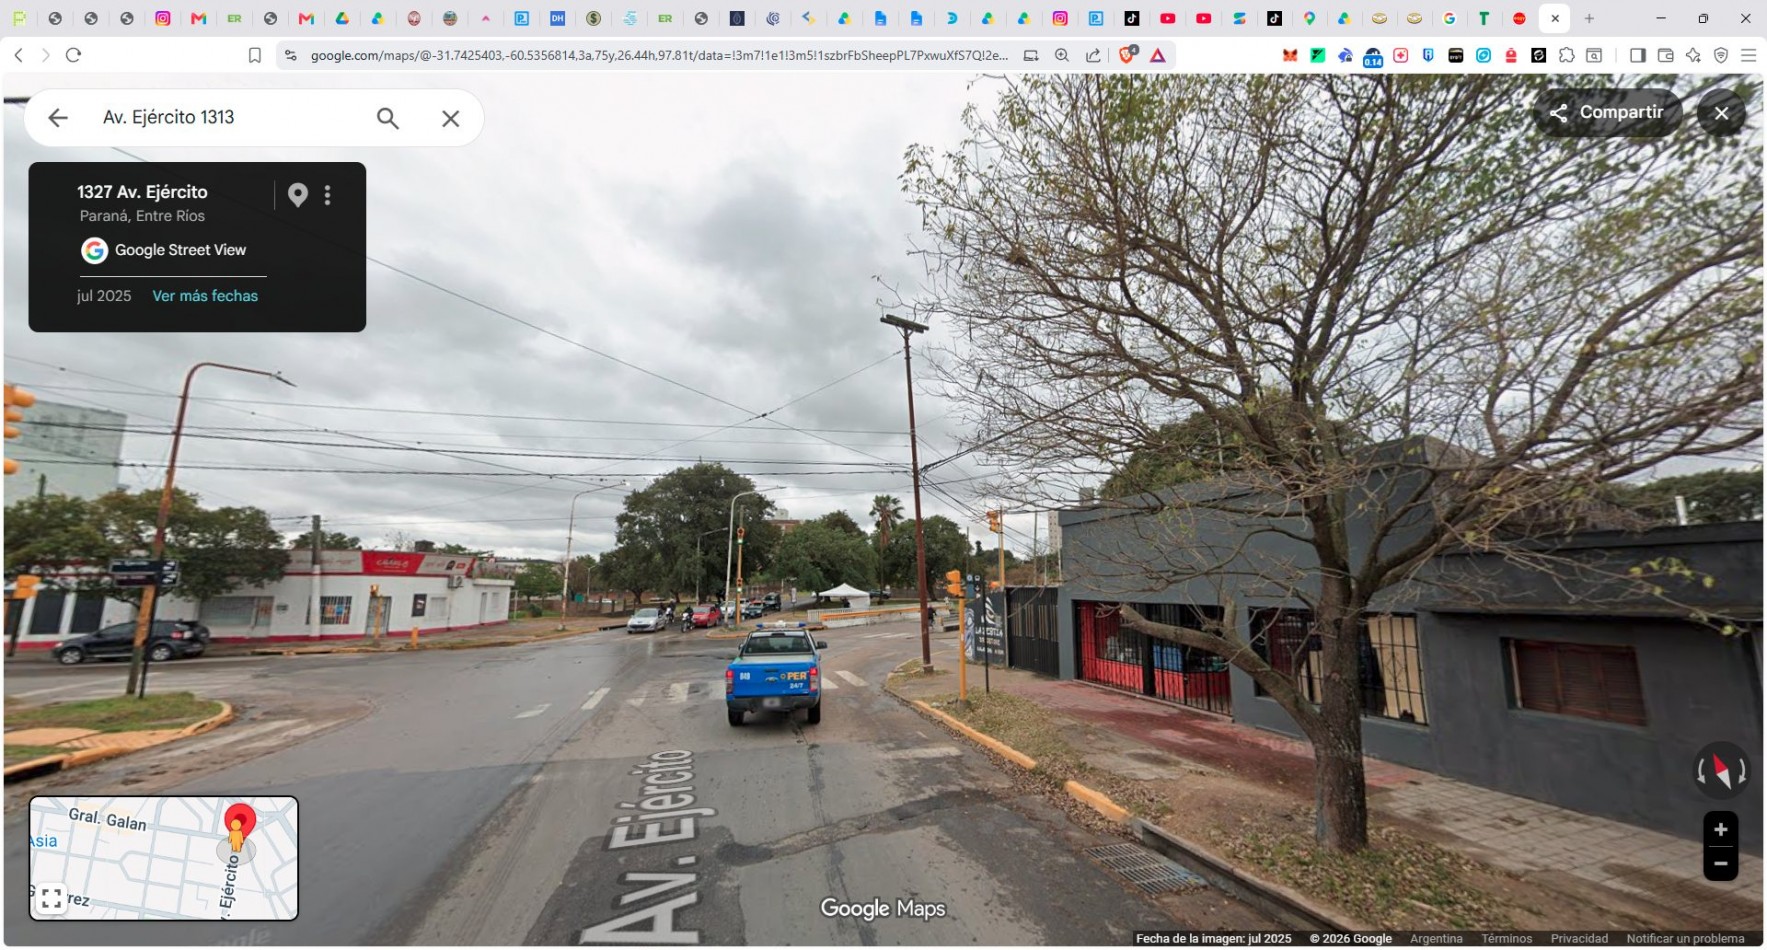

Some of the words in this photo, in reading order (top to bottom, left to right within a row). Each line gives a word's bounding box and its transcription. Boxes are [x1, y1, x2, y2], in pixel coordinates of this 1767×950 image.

[227, 14, 242, 23] ER
[658, 14, 673, 23] ER
[1364, 58, 1383, 66] 0.14
[787, 671, 807, 681] PER
